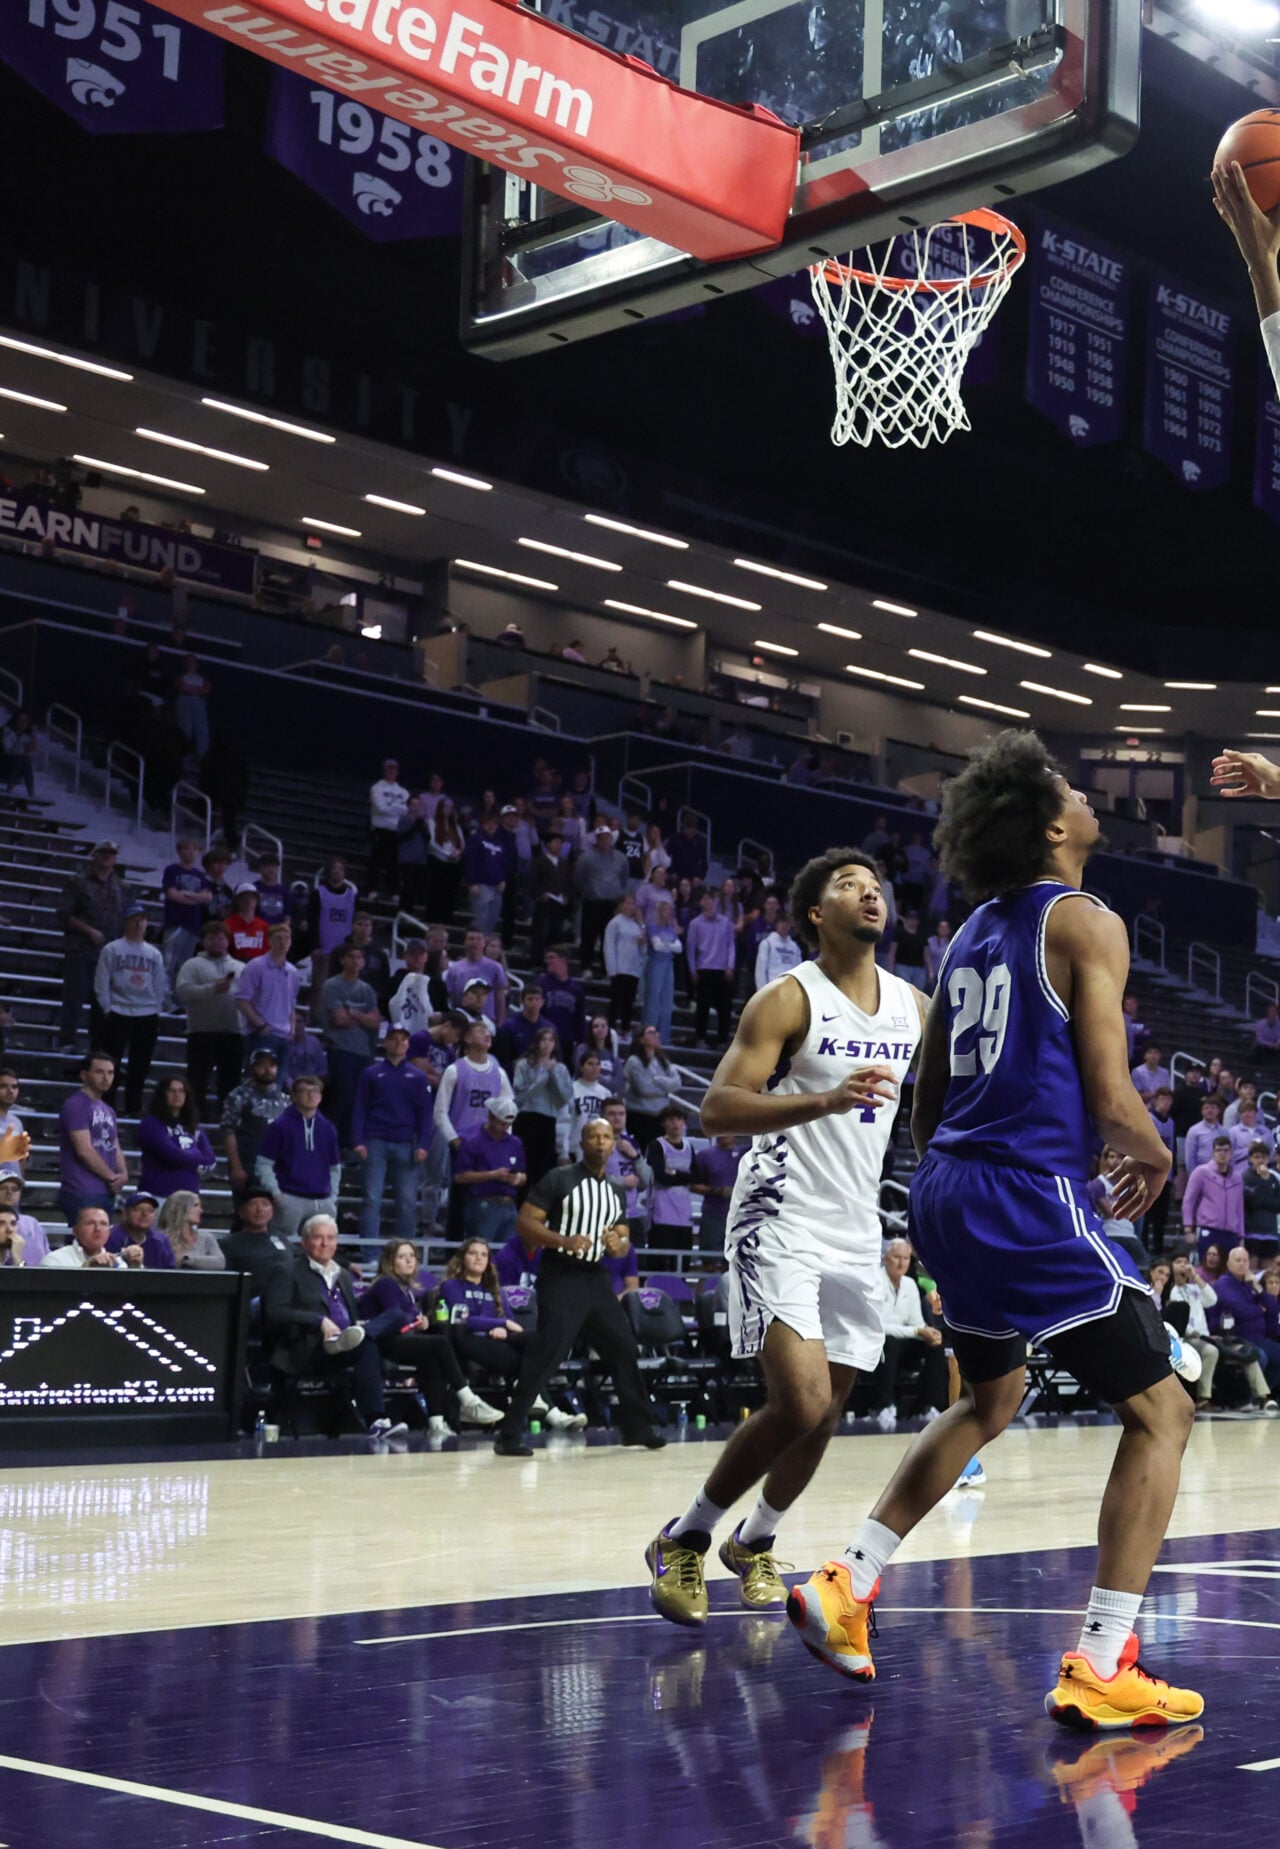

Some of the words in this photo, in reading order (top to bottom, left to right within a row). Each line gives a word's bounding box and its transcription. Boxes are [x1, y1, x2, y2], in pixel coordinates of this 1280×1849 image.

[547, 0, 681, 80] K-STAT
[305, 0, 594, 137] ateFarm
[310, 90, 452, 188] 1958
[1041, 230, 1123, 283] K-STATE
[1040, 285, 1123, 331] CHAMPIONSHIPS
[1050, 276, 1114, 315] CONFERENCE
[1156, 284, 1230, 334] K-STATE
[1049, 316, 1076, 337] 1917
[1087, 332, 1112, 354] 1951
[1049, 334, 1076, 355] 1919
[1086, 386, 1113, 407] 1959
[947, 963, 1011, 1077] 29
[817, 1037, 912, 1060] K-STATE
